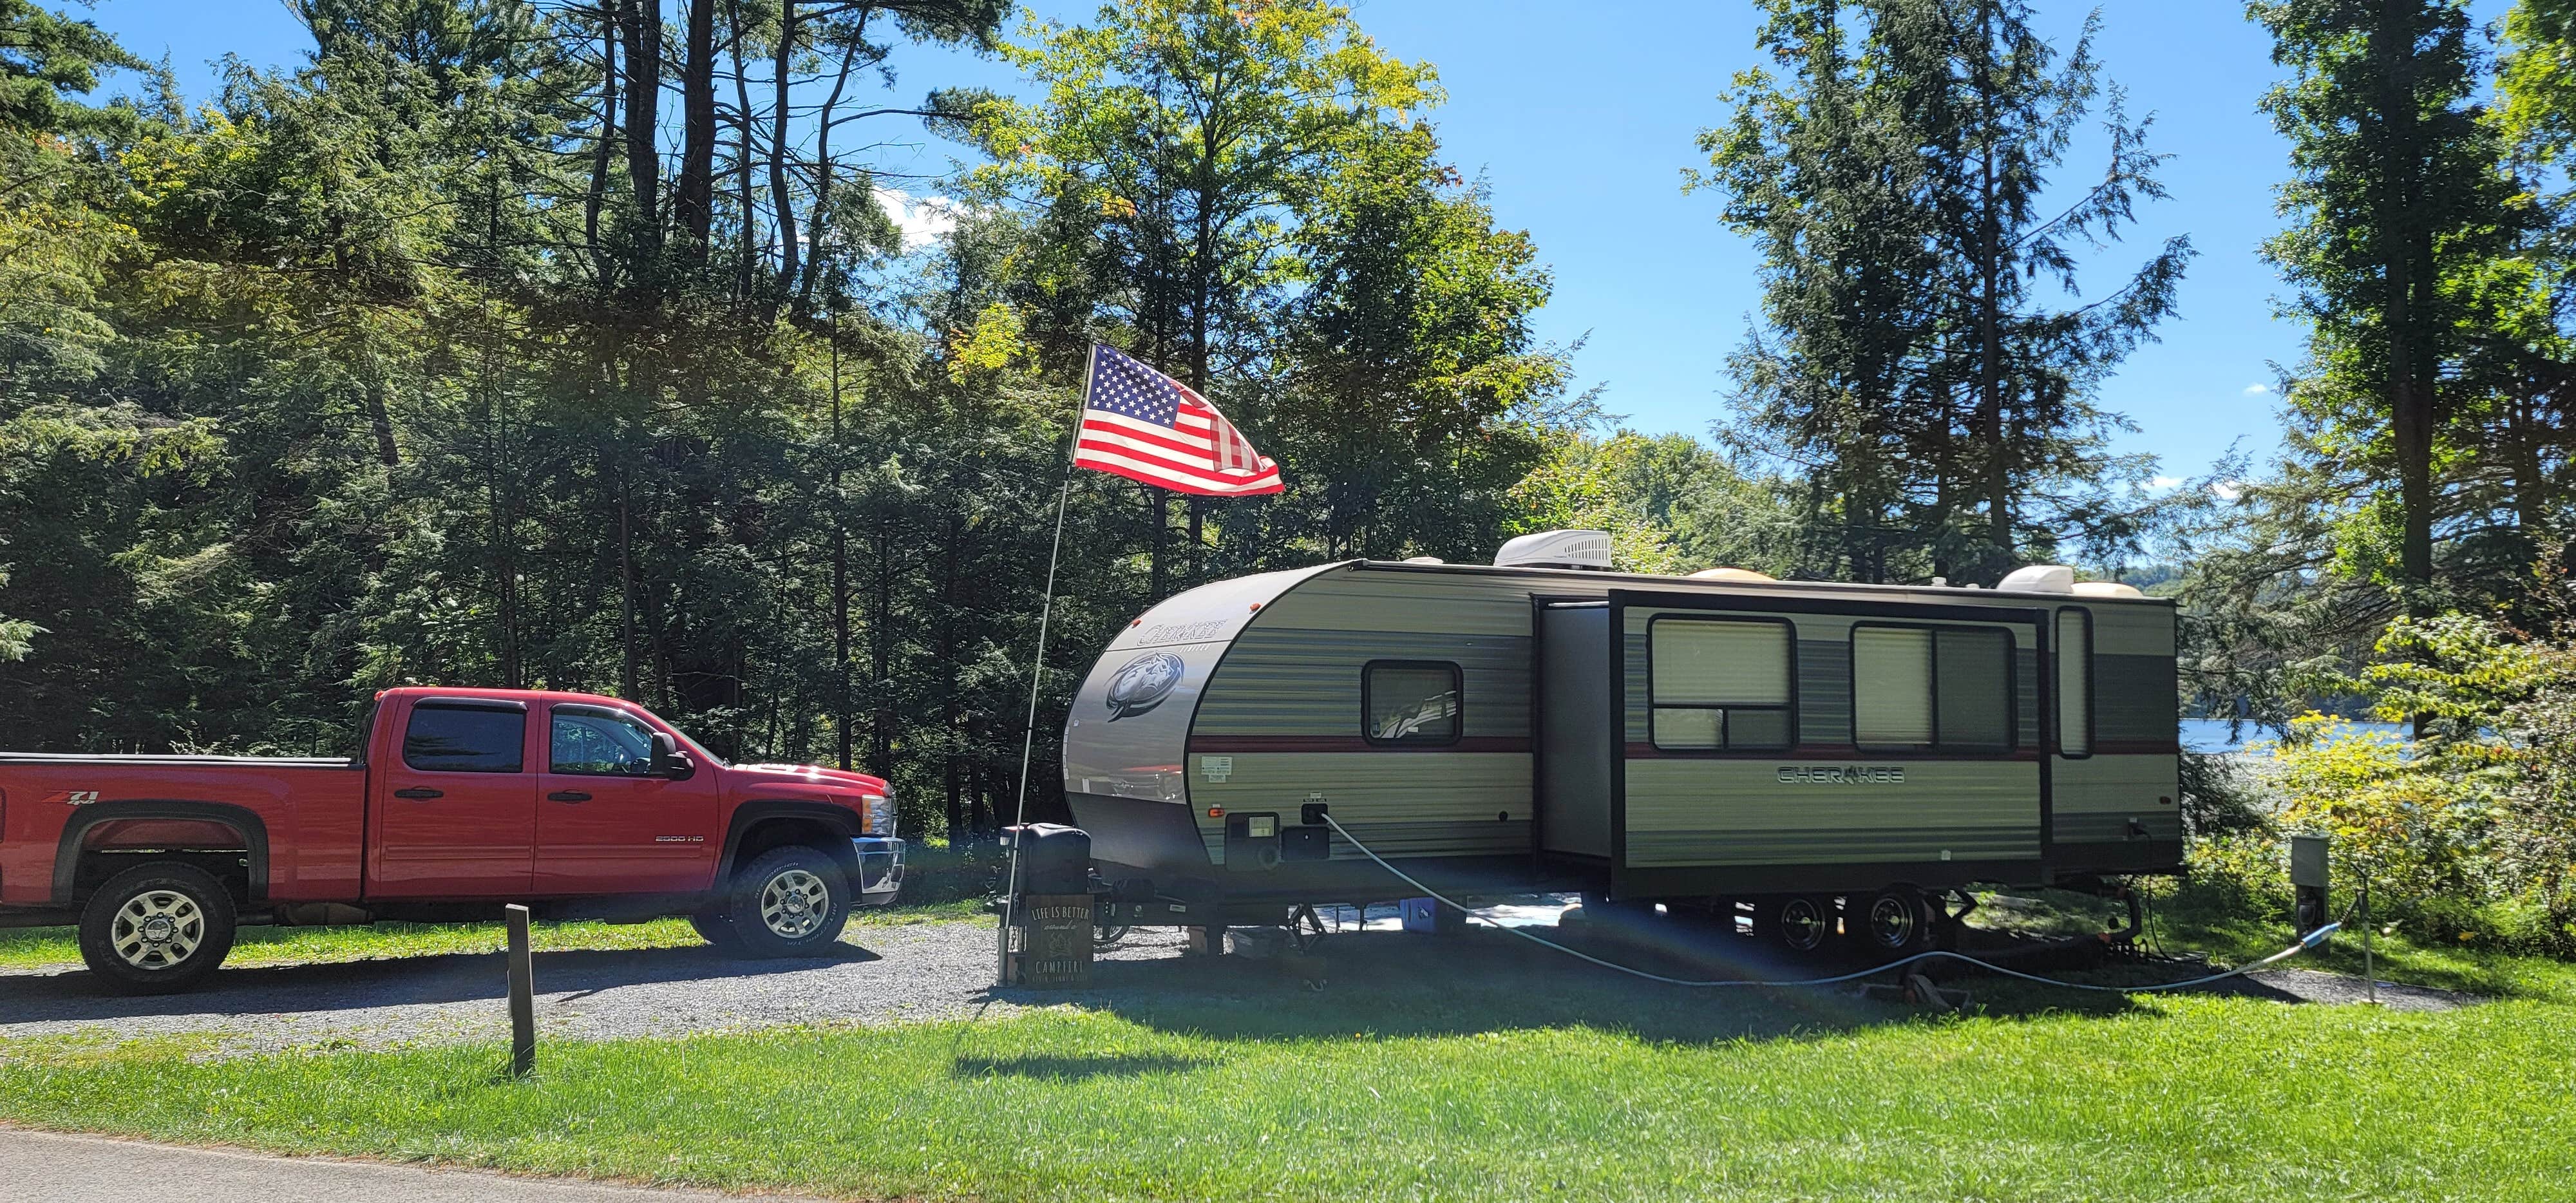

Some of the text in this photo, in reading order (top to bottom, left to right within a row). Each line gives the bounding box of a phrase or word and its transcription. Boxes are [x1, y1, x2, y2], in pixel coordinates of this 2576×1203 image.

[1137, 619, 1227, 646] CHEROKEE
[41, 790, 99, 803] Z71
[1032, 906, 1090, 921] LIFE IS BETTER
